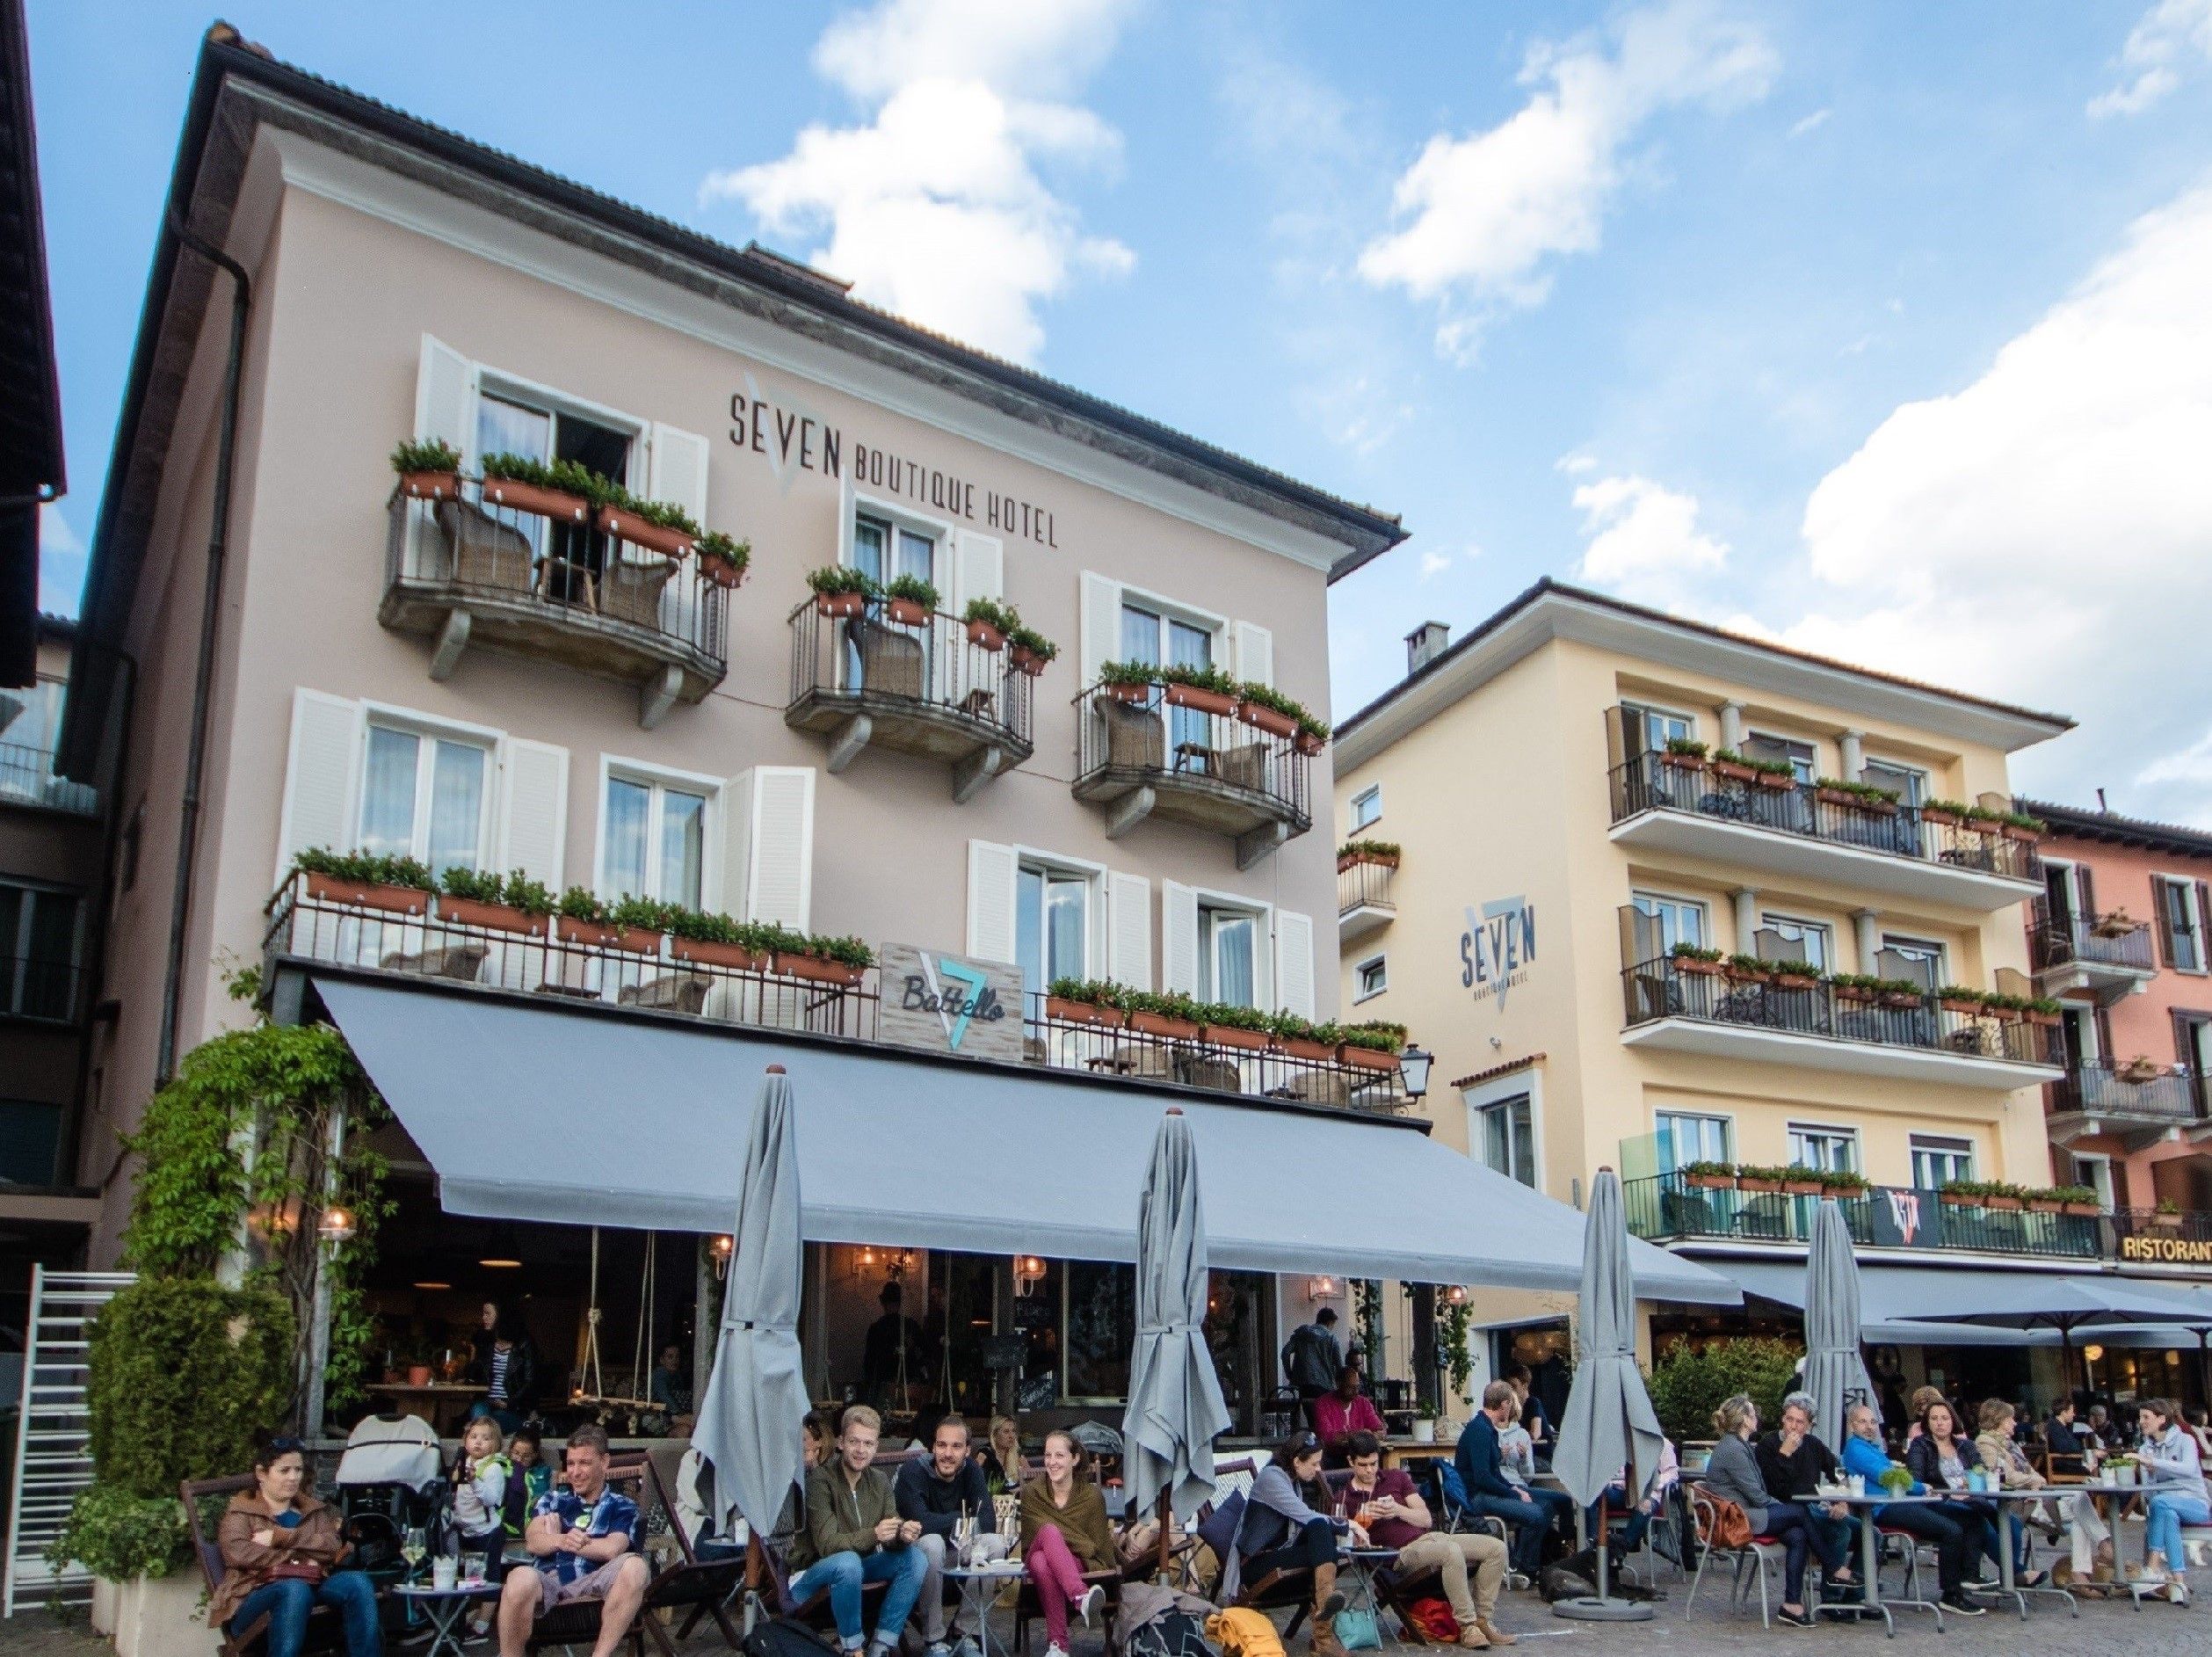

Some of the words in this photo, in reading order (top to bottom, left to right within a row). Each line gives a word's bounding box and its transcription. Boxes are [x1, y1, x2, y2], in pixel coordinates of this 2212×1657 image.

[729, 393, 840, 479] SEVEN
[855, 443, 975, 521] BOUTIQUE
[988, 491, 1058, 549] HOTEL
[1461, 904, 1535, 988] SEVEN
[902, 975, 1005, 1022] Battello
[2123, 1236, 2212, 1261] RISTORAN
